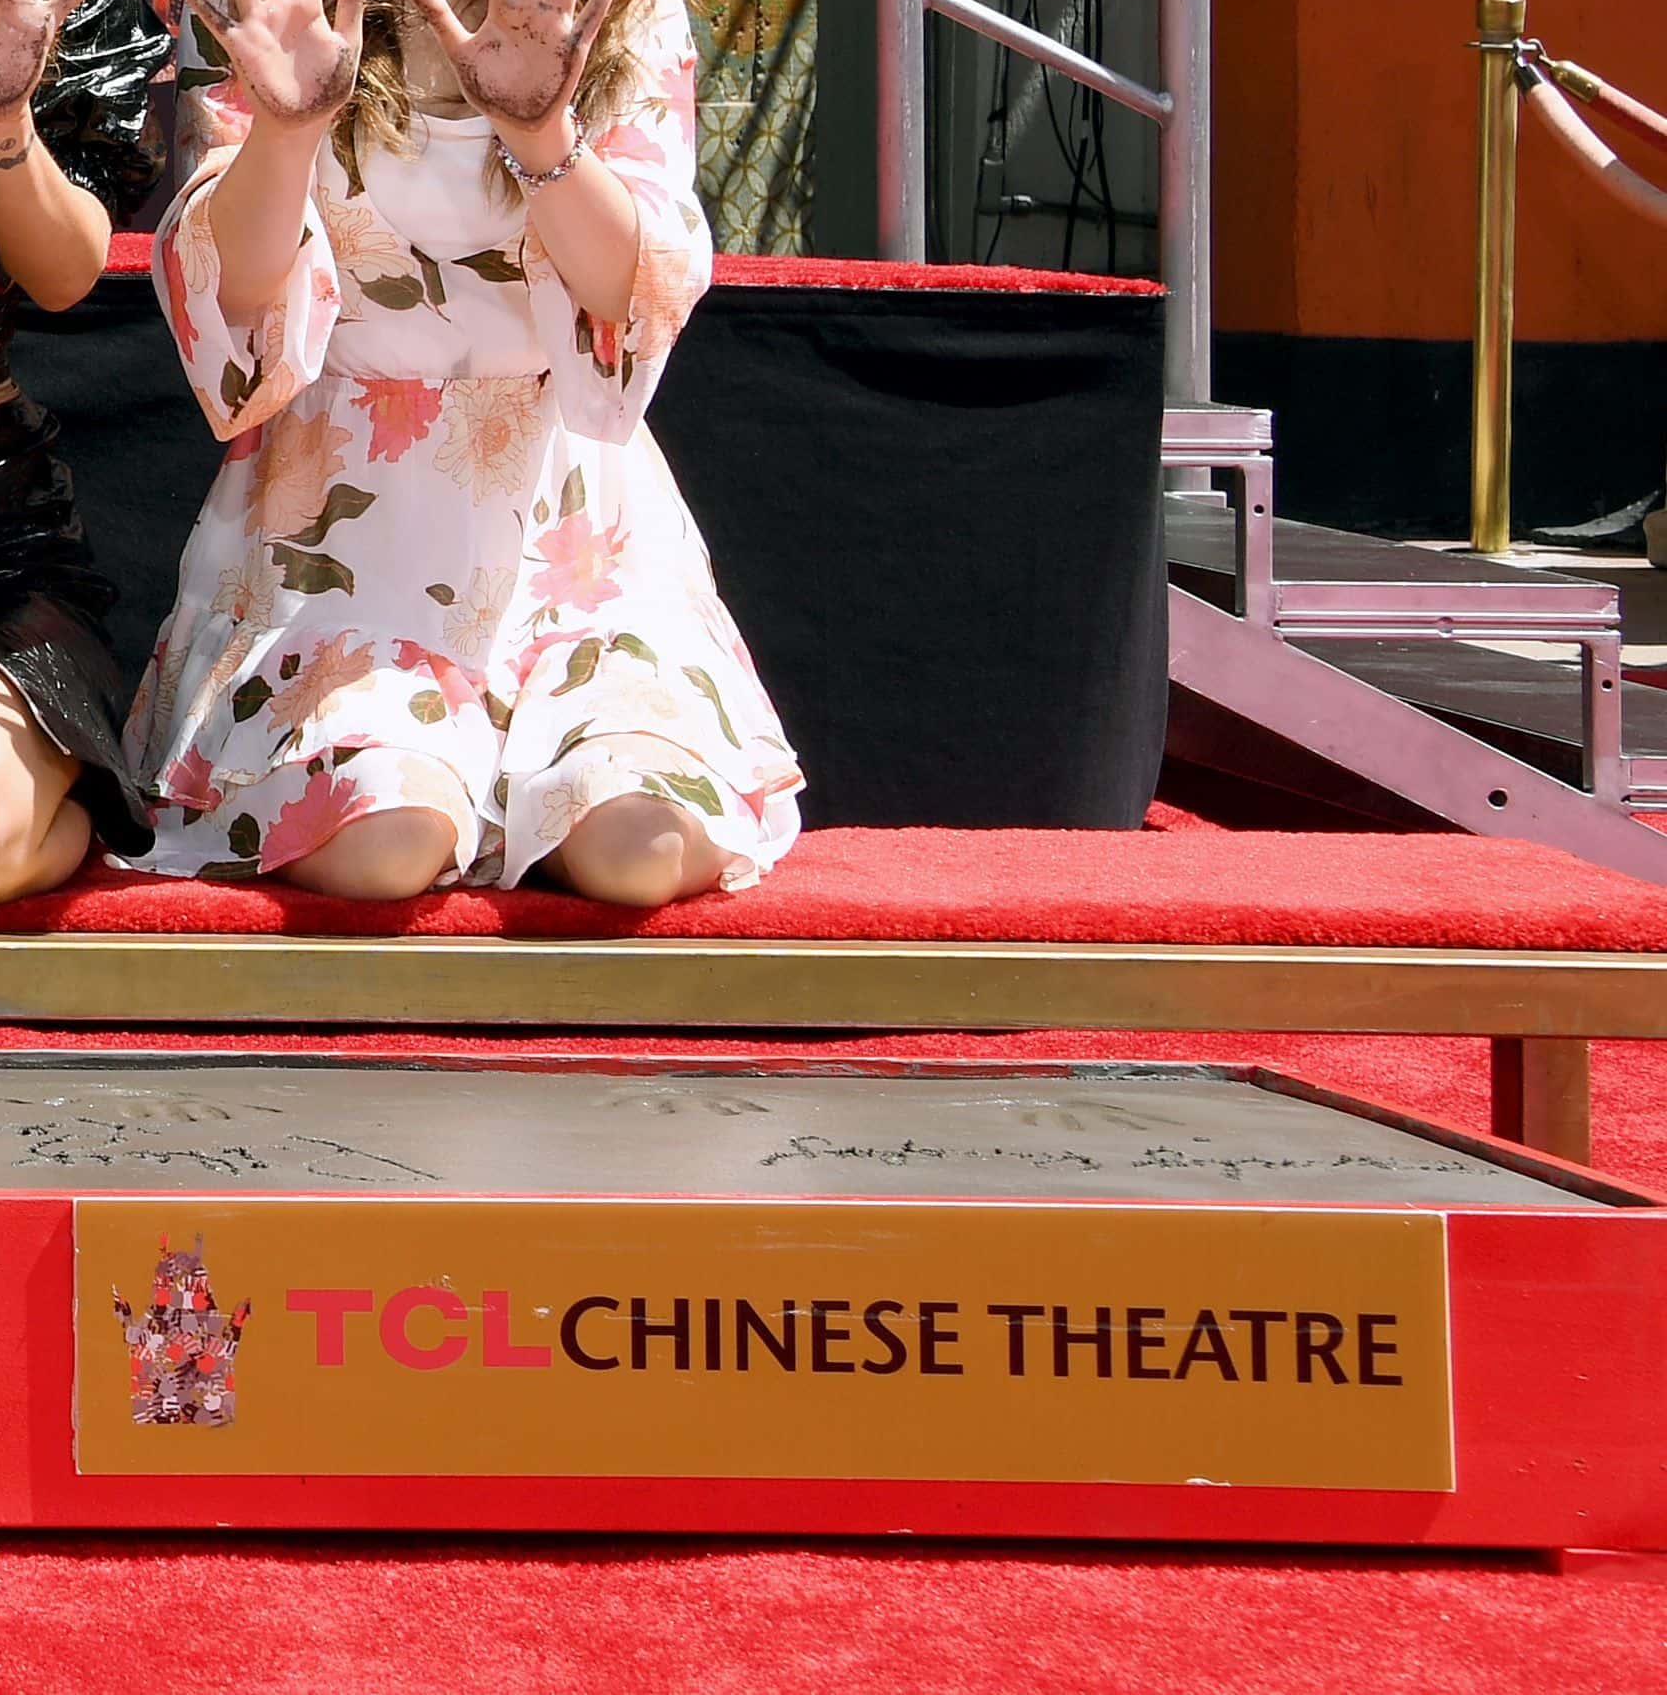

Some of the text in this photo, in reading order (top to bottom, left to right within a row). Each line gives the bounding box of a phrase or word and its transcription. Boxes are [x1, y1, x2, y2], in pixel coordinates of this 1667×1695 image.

[286, 1287, 1403, 1386] TCL CHINESE THEATRE
